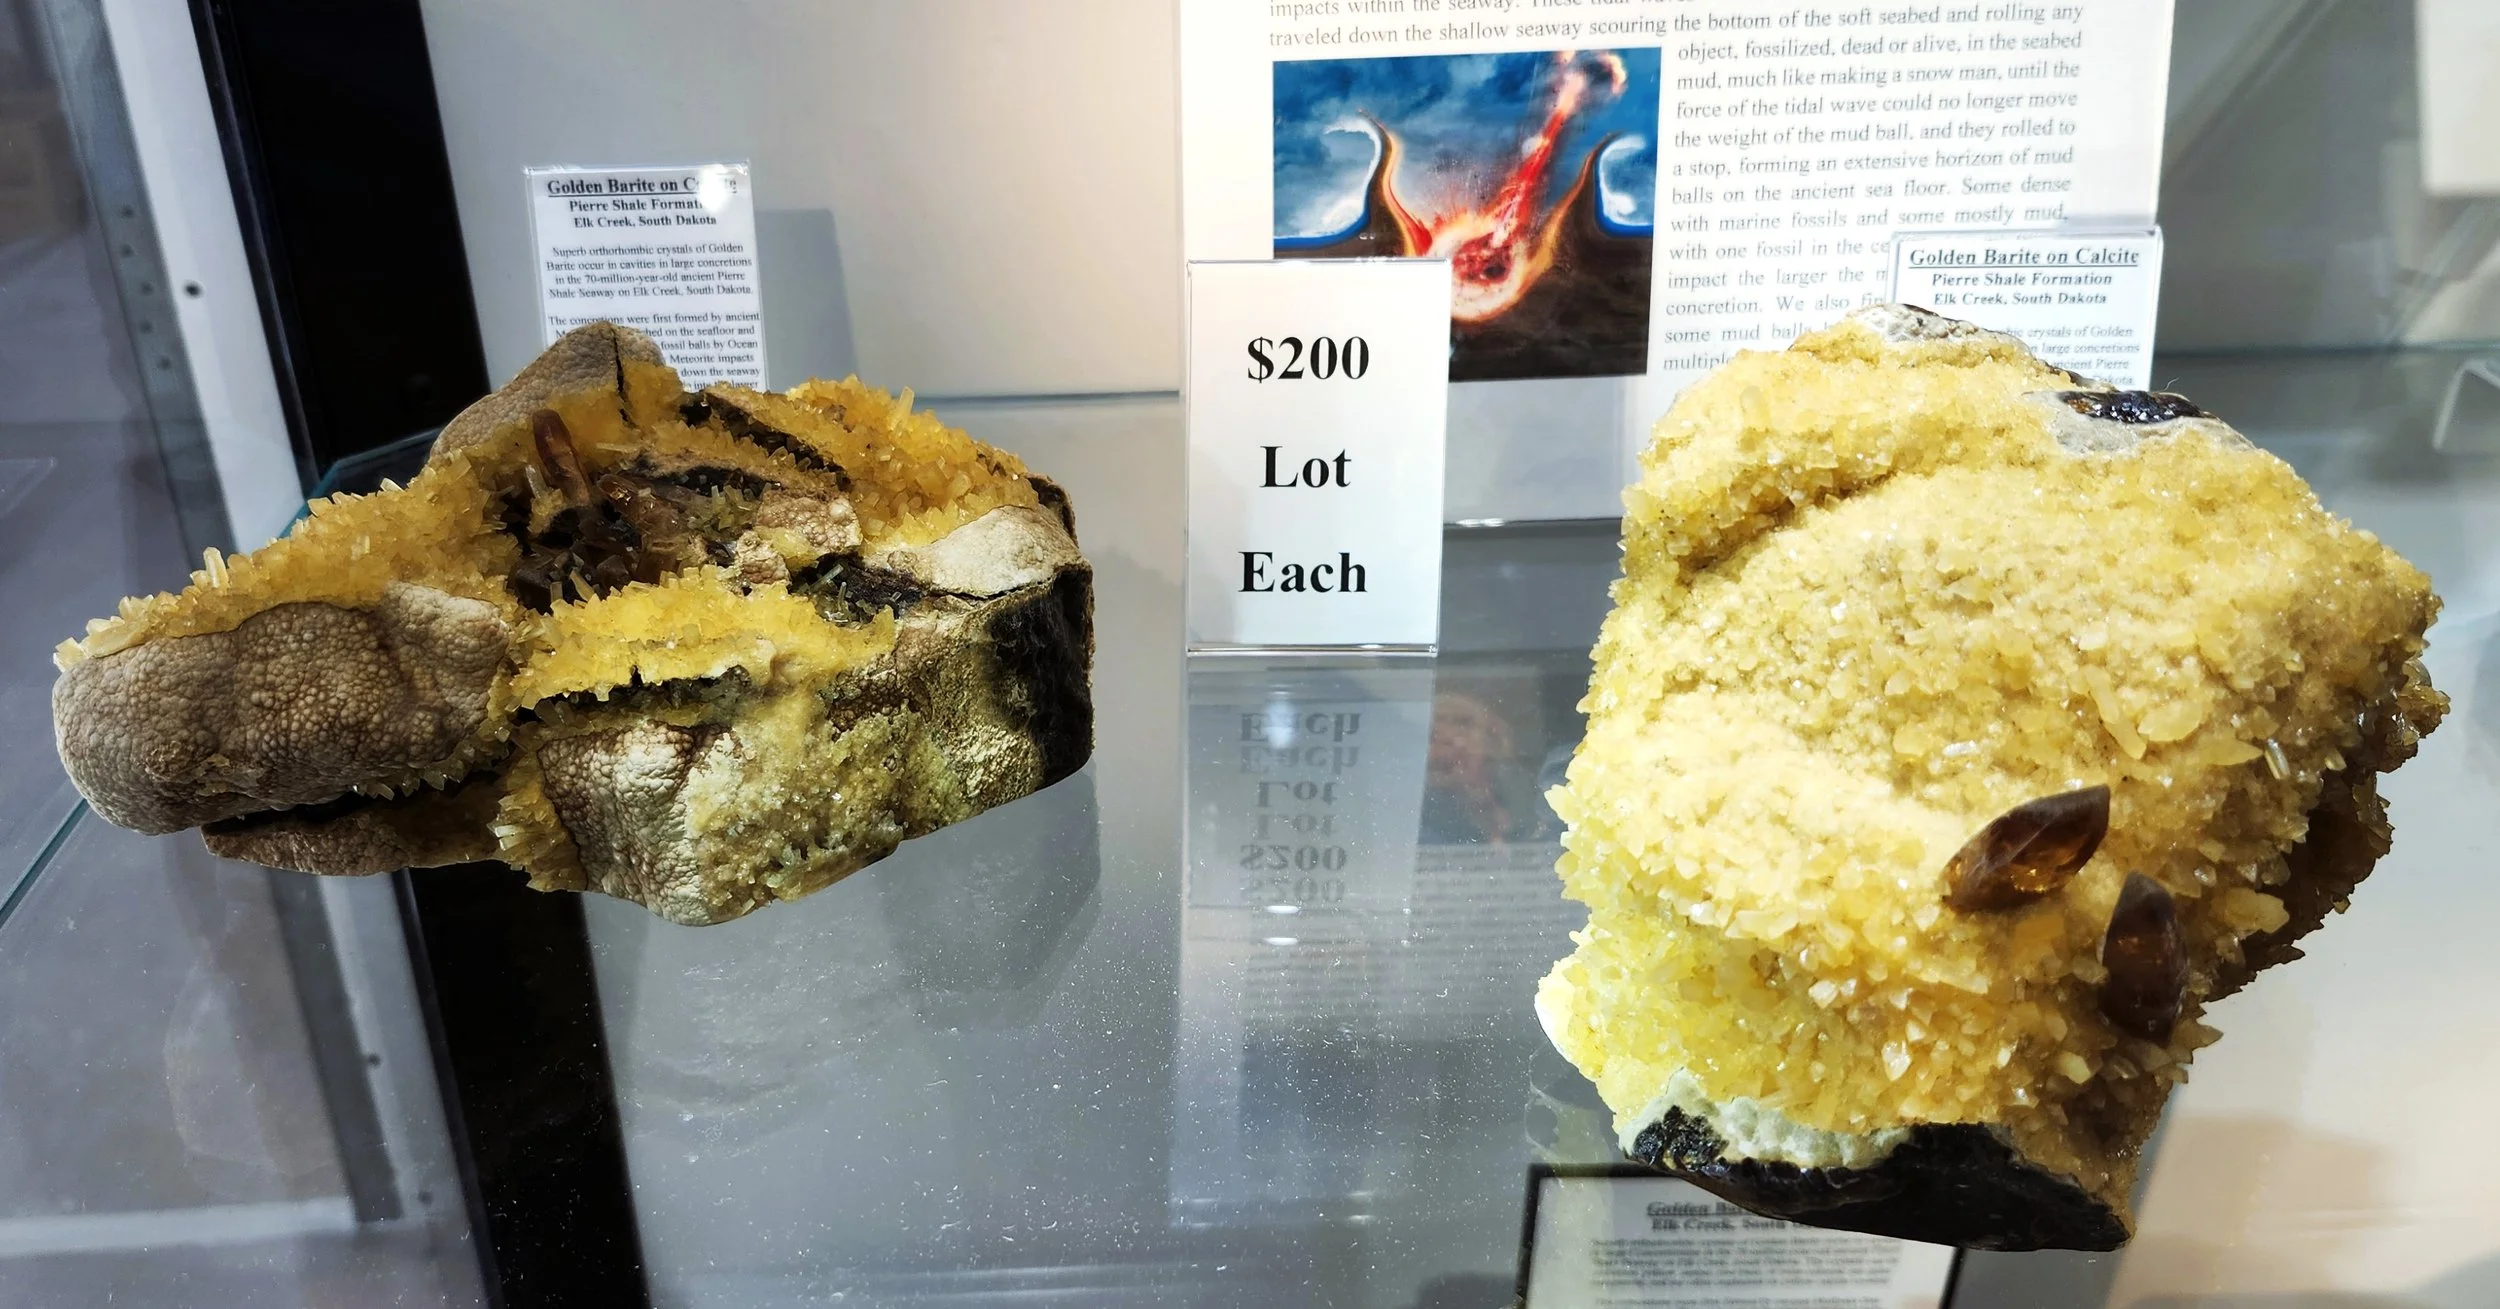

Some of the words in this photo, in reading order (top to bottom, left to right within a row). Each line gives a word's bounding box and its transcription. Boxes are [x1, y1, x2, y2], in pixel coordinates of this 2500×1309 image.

[1270, 0, 1340, 20] impacts
[1349, 0, 1404, 13] within
[1413, 0, 1440, 11] the
[1448, 0, 1519, 12] seaway.
[1270, 27, 1341, 46] traveled
[1349, 27, 1398, 43] down
[1405, 25, 1432, 41] the
[1439, 21, 1508, 40] shallow
[1516, 24, 1582, 39] seaway
[1589, 17, 1667, 37] scouring
[1675, 14, 1701, 31] the
[1708, 13, 1770, 30] bottom
[1779, 10, 1799, 28] of
[1805, 10, 1831, 27] the
[1838, 8, 1871, 26] soft
[1879, 7, 1939, 24] seabed
[1947, 6, 1979, 22] and
[1986, 4, 2045, 24] rolling
[2052, 5, 2084, 24] any
[1678, 42, 1738, 64] object,
[1745, 38, 1836, 59] fossilized,
[1841, 36, 1883, 54] dead
[1889, 41, 1908, 53] or
[1913, 34, 1961, 54] alive,
[1967, 33, 1983, 50] in
[1990, 33, 2017, 50] the
[2021, 31, 2082, 50] seabed
[1677, 72, 1722, 90] mud,
[1728, 70, 1776, 87] much
[1783, 68, 1815, 86] like
[1821, 66, 1887, 88] making
[1892, 71, 1901, 83] a
[1907, 67, 1953, 82] snow
[1959, 66, 2002, 82] man,
[2007, 61, 2047, 79] until
[2053, 60, 2080, 78] the
[1677, 101, 1722, 119] force
[1728, 99, 1748, 117] of
[1752, 98, 1779, 116] the
[1785, 97, 1824, 115] tidal
[1831, 99, 1877, 113] wave
[1882, 94, 1932, 111] could
[1938, 96, 1960, 110] no
[1966, 92, 2023, 113] longer
[2028, 93, 2078, 107] move
[1674, 130, 1701, 147] the
[1708, 128, 1767, 150] weight
[1773, 127, 1793, 144] of
[1798, 126, 1825, 143] the
[1830, 125, 1870, 142] mud
[1875, 122, 1914, 141] ball,
[1920, 121, 1952, 140] and
[1958, 120, 1995, 142] they
[2001, 118, 2053, 137] rolled
[2059, 119, 2075, 136] to
[1673, 164, 1682, 176] a
[1689, 161, 1731, 179] stop,
[1740, 156, 1810, 176] forming
[1816, 158, 1837, 171] an
[1844, 153, 1928, 170] extensive
[1935, 149, 2003, 168] horizon
[2009, 147, 2029, 165] of
[2034, 146, 2073, 165] mud
[547, 179, 602, 194] Golden
[608, 178, 655, 193] Barite
[660, 180, 678, 191] on
[1672, 187, 1713, 204] balls
[1723, 190, 1744, 202] on
[1755, 184, 1781, 202] the
[1791, 183, 1855, 200] ancient
[1865, 184, 1893, 198] sea
[1904, 179, 1950, 197] floor.
[1961, 176, 2012, 194] Some
[2021, 174, 2072, 193] dense
[570, 200, 608, 212] Pierre
[613, 199, 647, 211] Shale
[574, 217, 594, 228] Elk
[598, 216, 635, 228] Creek,
[639, 215, 672, 226] South
[676, 214, 717, 225] Dakota
[1670, 215, 1708, 232] with
[1719, 214, 1780, 230] marine
[1792, 209, 1847, 228] fossils
[1856, 209, 1888, 226] and
[1898, 208, 1944, 224] some
[1955, 203, 2014, 225] mostly
[2024, 201, 2068, 221] mud,
[553, 246, 586, 258] Superb
[589, 246, 653, 256] orthorhombic
[657, 245, 693, 256] crystals
[708, 243, 744, 253] Golden
[1670, 244, 1707, 261] with
[1716, 245, 1747, 260] one
[1757, 240, 1802, 258] fossil
[1812, 241, 1827, 255] in
[1837, 238, 1863, 255] the
[1910, 248, 1976, 265] Golden
[1984, 248, 2040, 265] Barite
[2047, 252, 2067, 265] on
[2076, 247, 2139, 264] Calcite
[547, 261, 575, 271] Barite
[578, 262, 604, 271] occur
[620, 260, 655, 270] cavities
[671, 258, 695, 270] large
[698, 258, 752, 268] concretions
[568, 275, 582, 284] the
[585, 273, 678, 286] 70-million-year-old
[681, 272, 715, 281] ancient
[718, 271, 746, 281] Pierre
[1668, 272, 1728, 292] impact
[1738, 269, 1764, 286] the
[1777, 268, 1827, 287] larger
[1838, 266, 1864, 282] the
[1932, 273, 1978, 286] Pierre
[1984, 272, 2025, 286] Shale
[2031, 272, 2112, 286] Formation
[549, 288, 575, 299] Shale
[579, 288, 614, 300] Seaway
[634, 287, 650, 296] Elk
[652, 286, 683, 297] Creek,
[686, 286, 714, 295] South
[1934, 293, 1956, 305] Elk
[1963, 293, 2008, 305] Creek,
[2013, 292, 2051, 305] South
[2058, 292, 2106, 304] Dakota
[1666, 298, 1763, 316] concretion.
[1776, 296, 1805, 311] We
[1815, 294, 1849, 310] also
[549, 316, 567, 326] The
[627, 316, 650, 324] were
[653, 314, 673, 324] first
[674, 312, 708, 323] formed
[726, 312, 760, 322] ancient
[1665, 329, 1710, 343] some
[1722, 324, 1760, 340] mud
[2027, 327, 2071, 338] crystals
[2075, 327, 2087, 337] of
[2090, 326, 2133, 337] Golden
[2041, 343, 2070, 354] large
[2073, 343, 2140, 354] concretions
[670, 354, 714, 364] Meteorite
[718, 354, 754, 365] impacts
[1247, 336, 1370, 384] $200
[2095, 359, 2129, 369] Pierre
[1259, 445, 1352, 488] Lot
[1238, 551, 1368, 593] Each
